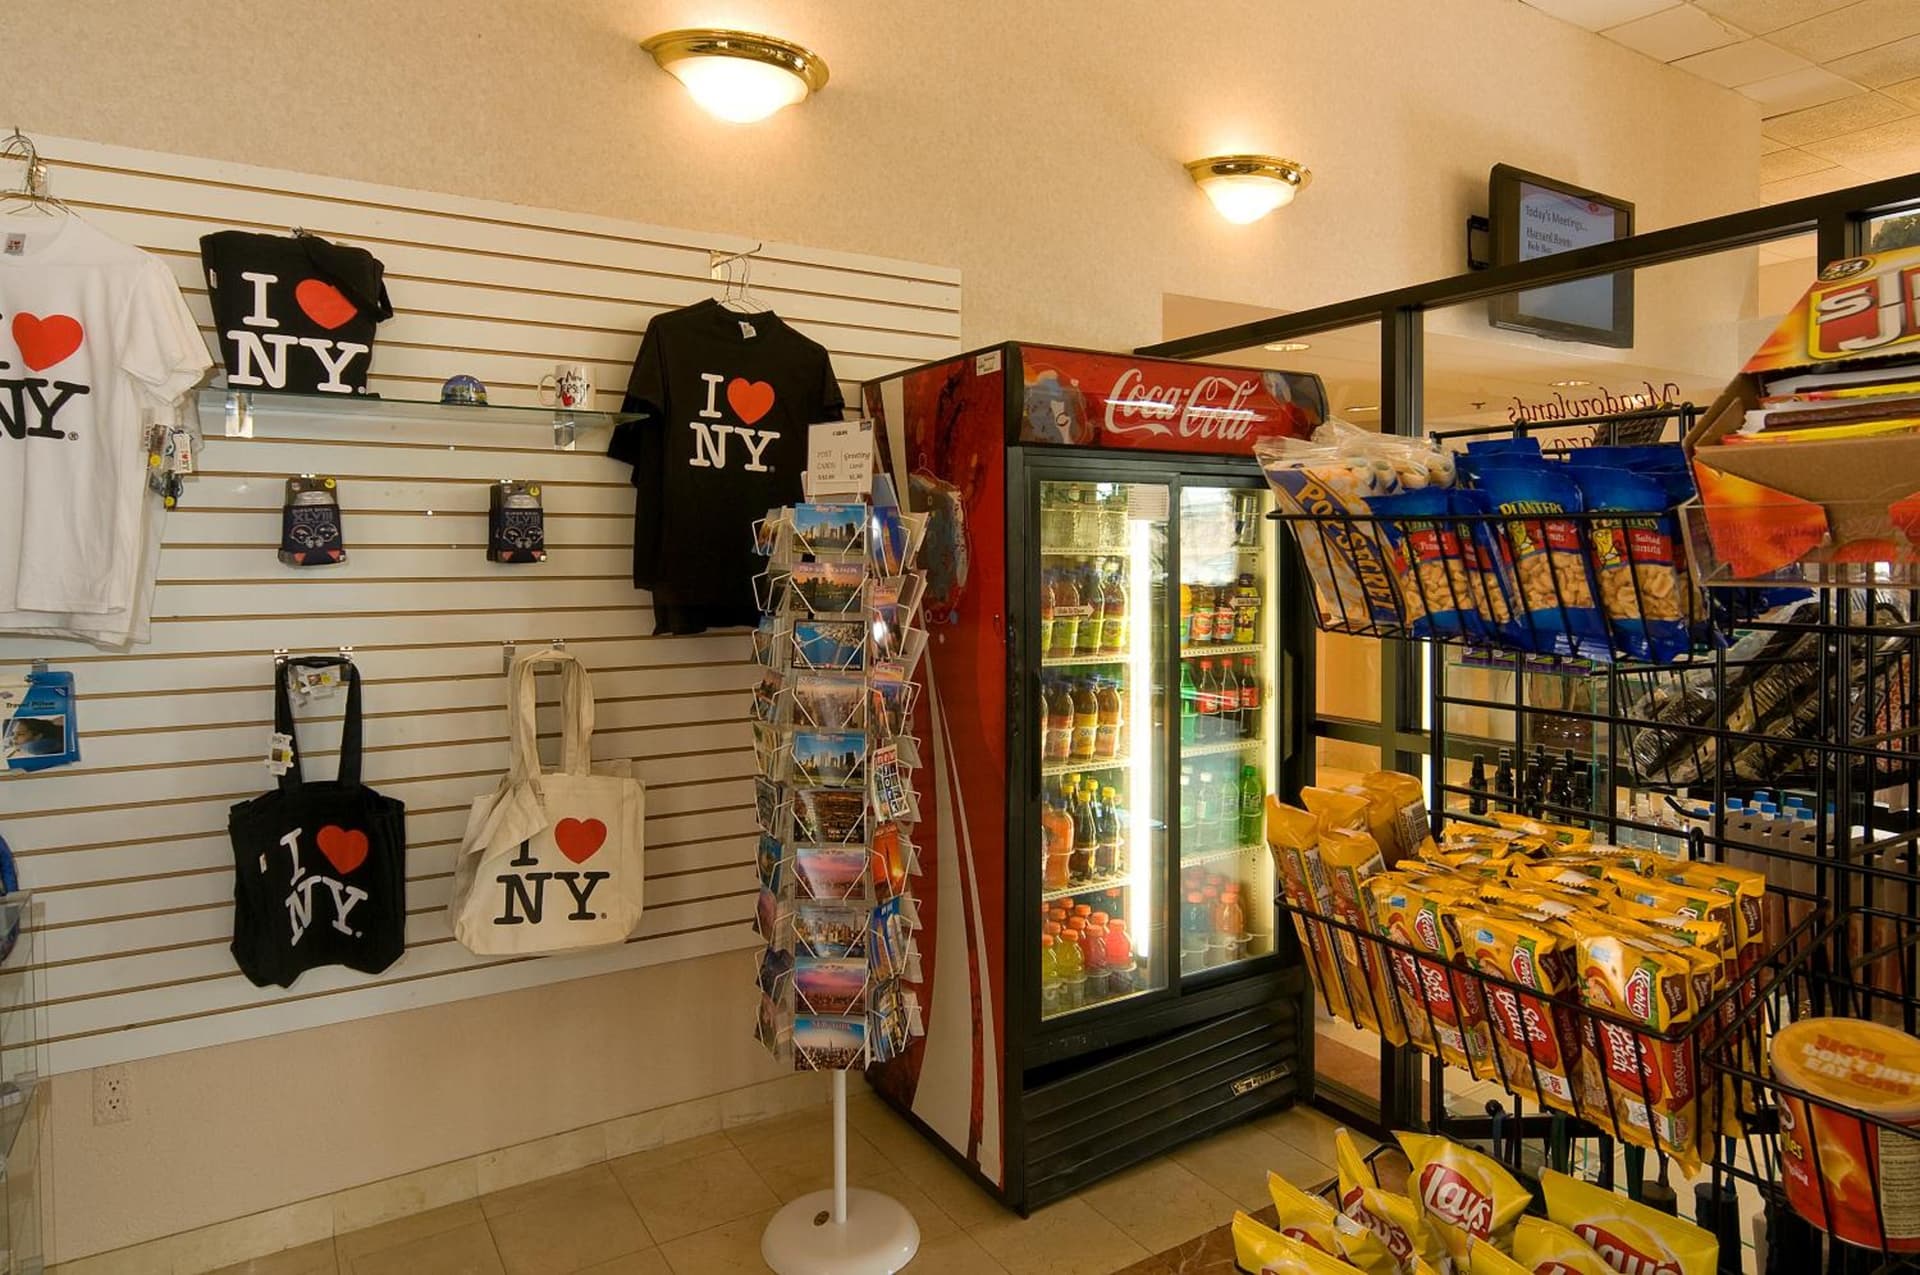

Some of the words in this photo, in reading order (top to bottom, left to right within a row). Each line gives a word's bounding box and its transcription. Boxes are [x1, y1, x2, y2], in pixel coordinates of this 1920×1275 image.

[241, 271, 279, 329] I
[698, 372, 725, 419] I
[1104, 367, 1260, 441] Coca-Cola
[689, 422, 781, 473] NY
[280, 827, 306, 887] I
[285, 875, 369, 947] NY
[493, 871, 611, 926] NY
[1421, 965, 1450, 1003] Soft
[1513, 946, 1538, 988] Keeble
[1626, 969, 1650, 1020] Keebler
[1520, 1003, 1548, 1044] Soft
[1549, 1076, 1563, 1096] USA
[1424, 1165, 1491, 1233] Lay's
